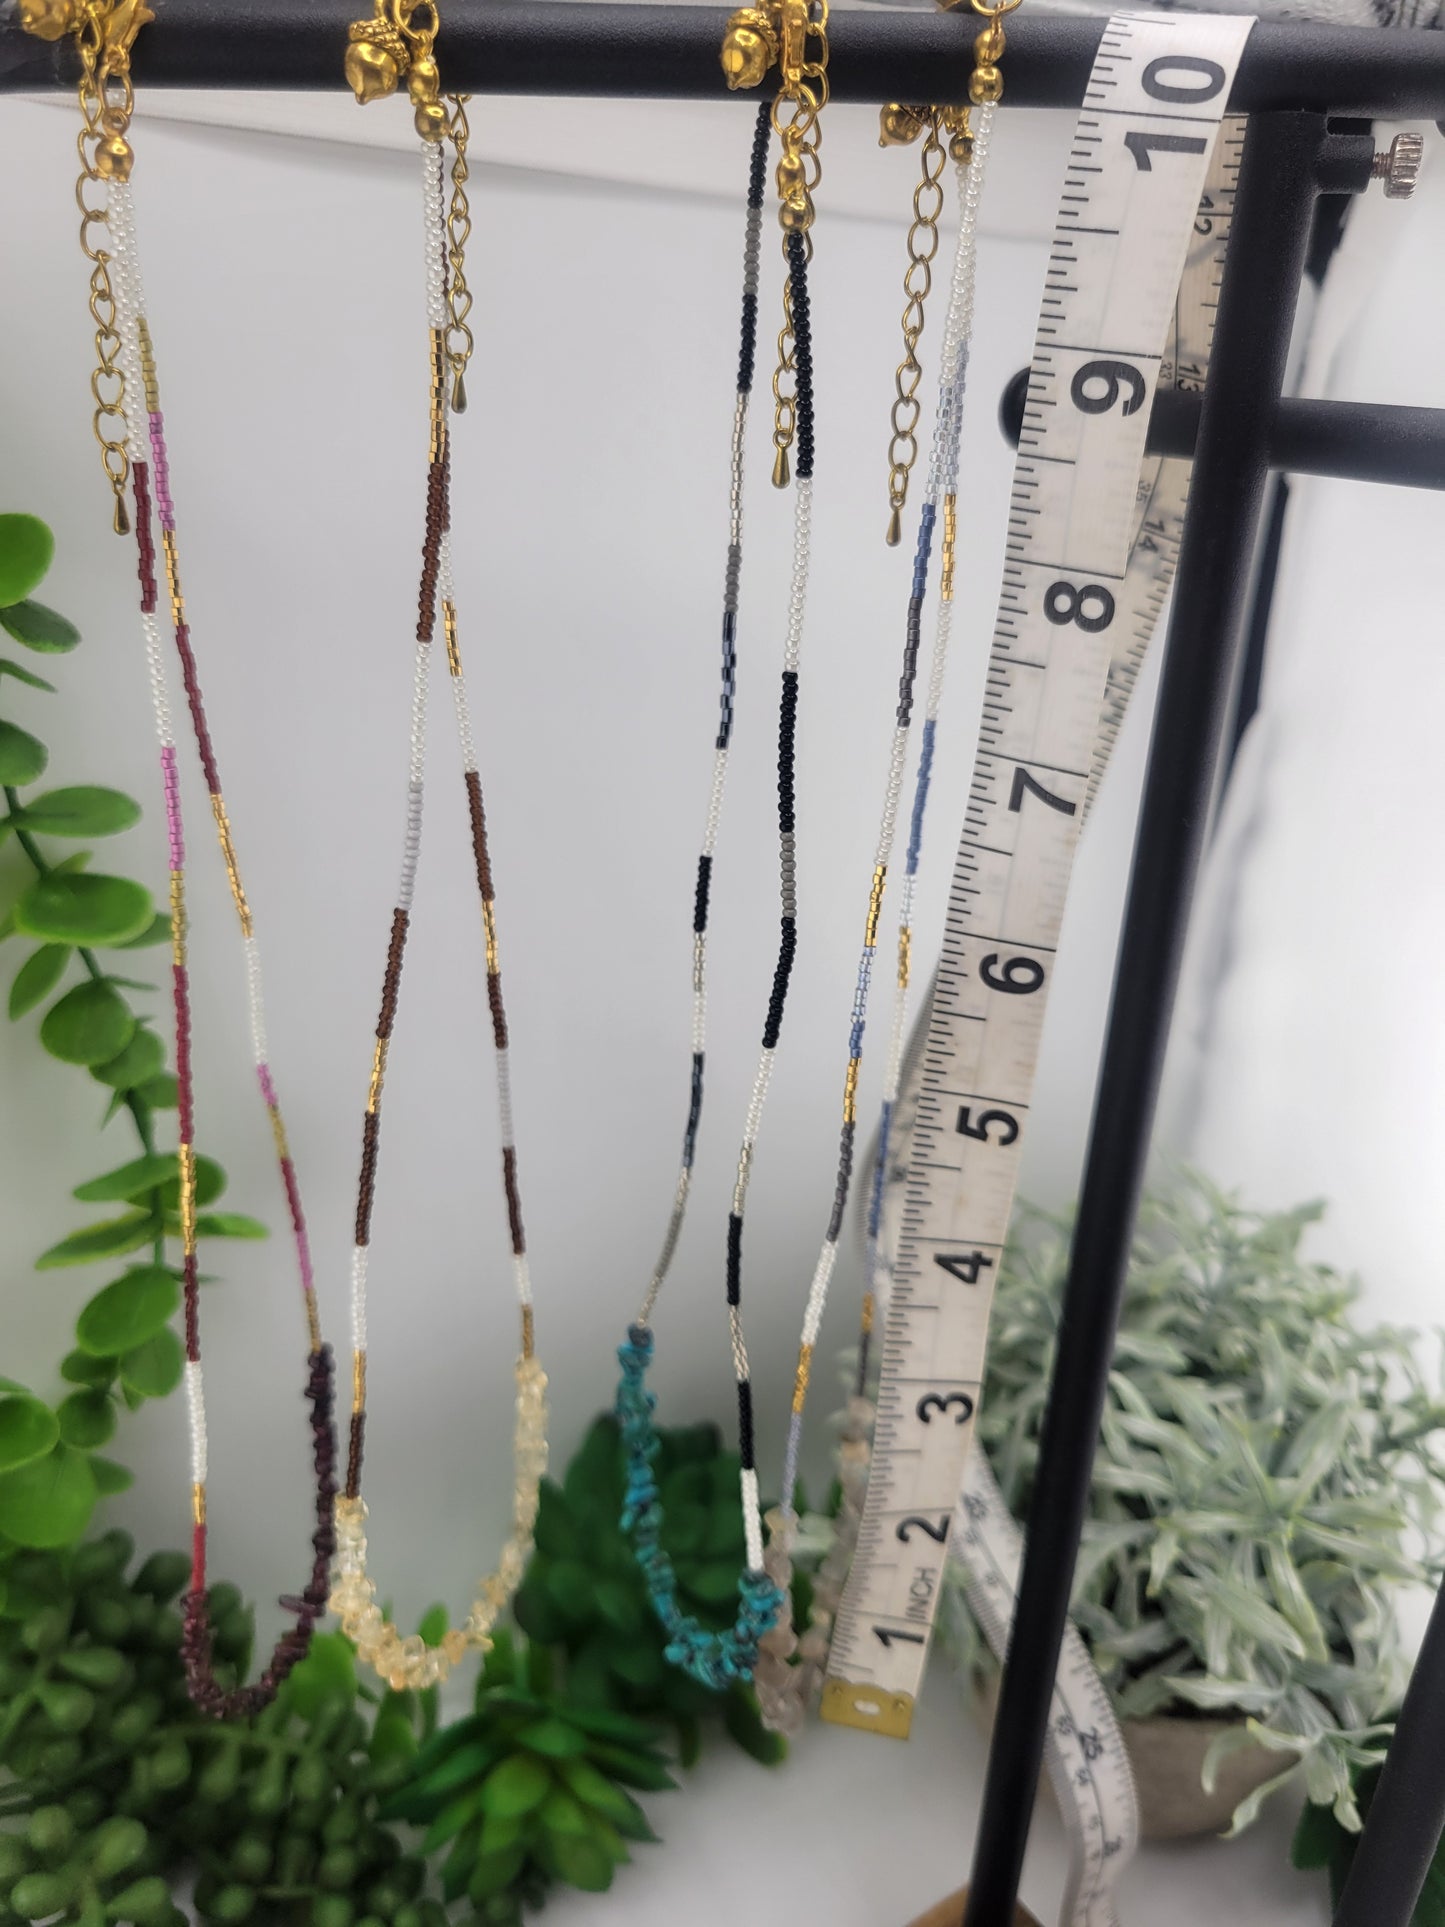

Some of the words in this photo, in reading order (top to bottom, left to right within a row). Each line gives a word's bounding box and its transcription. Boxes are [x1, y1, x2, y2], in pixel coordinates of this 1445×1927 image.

[1124, 55, 1226, 171] 10
[1070, 360, 1146, 417] 9
[1138, 519, 1166, 555] 14
[1043, 581, 1115, 633] 8
[1008, 767, 1076, 816] 7
[979, 953, 1045, 995] 6
[955, 1105, 1019, 1146] 5
[934, 1251, 993, 1284] 4
[916, 1392, 974, 1424] 3
[896, 1514, 950, 1543] 2
[905, 1566, 937, 1610] INCH
[872, 1625, 925, 1648] 1
